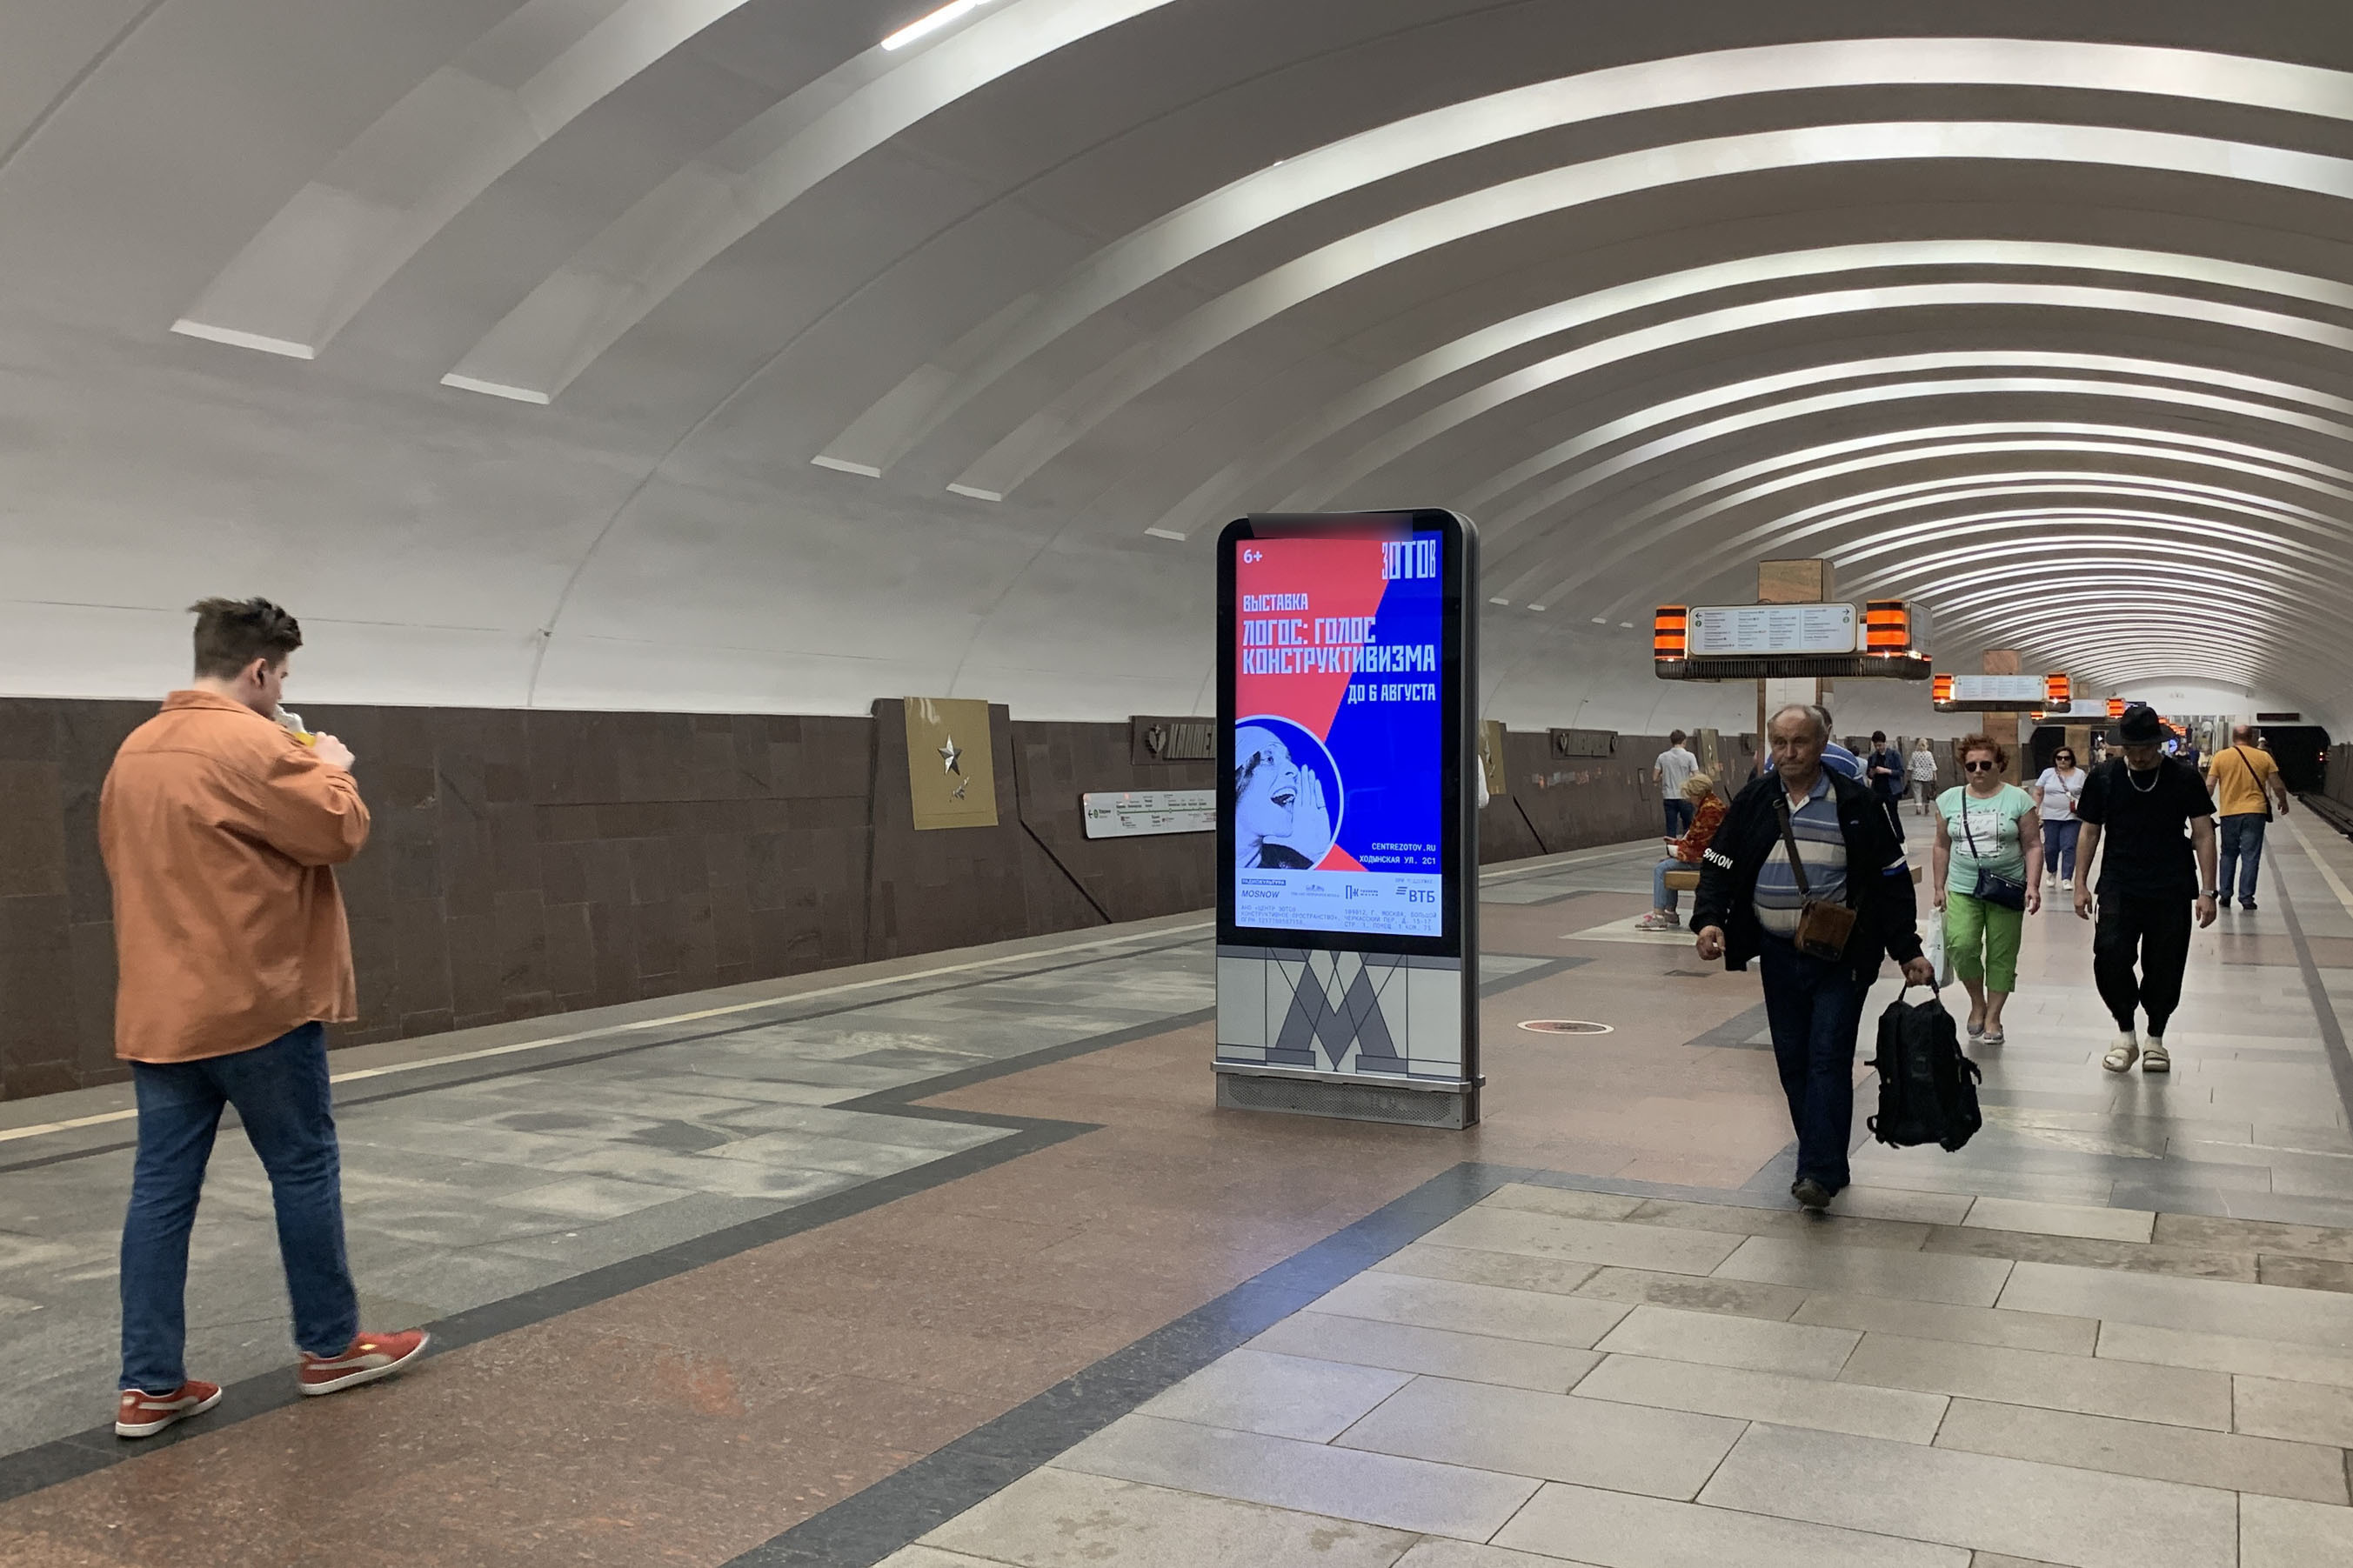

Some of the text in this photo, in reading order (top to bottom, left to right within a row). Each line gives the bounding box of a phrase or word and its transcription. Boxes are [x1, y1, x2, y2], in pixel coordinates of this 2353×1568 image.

[1243, 550, 1262, 564] 6+
[1381, 539, 1435, 579] ЗОТОВ
[1243, 593, 1308, 612] ВЫСТАВКА
[1243, 617, 1376, 645] ЛОГОС: ГОЛОС
[1243, 645, 1435, 674] КОНСТРУКТИВИЗМА
[1348, 684, 1436, 704] ДО 6 АВГУСТА
[1372, 843, 1436, 851] CENTREZOTOV.RU
[1359, 855, 1400, 864] ХОДЫНСКАЯ
[1409, 890, 1435, 903] ВТБ
